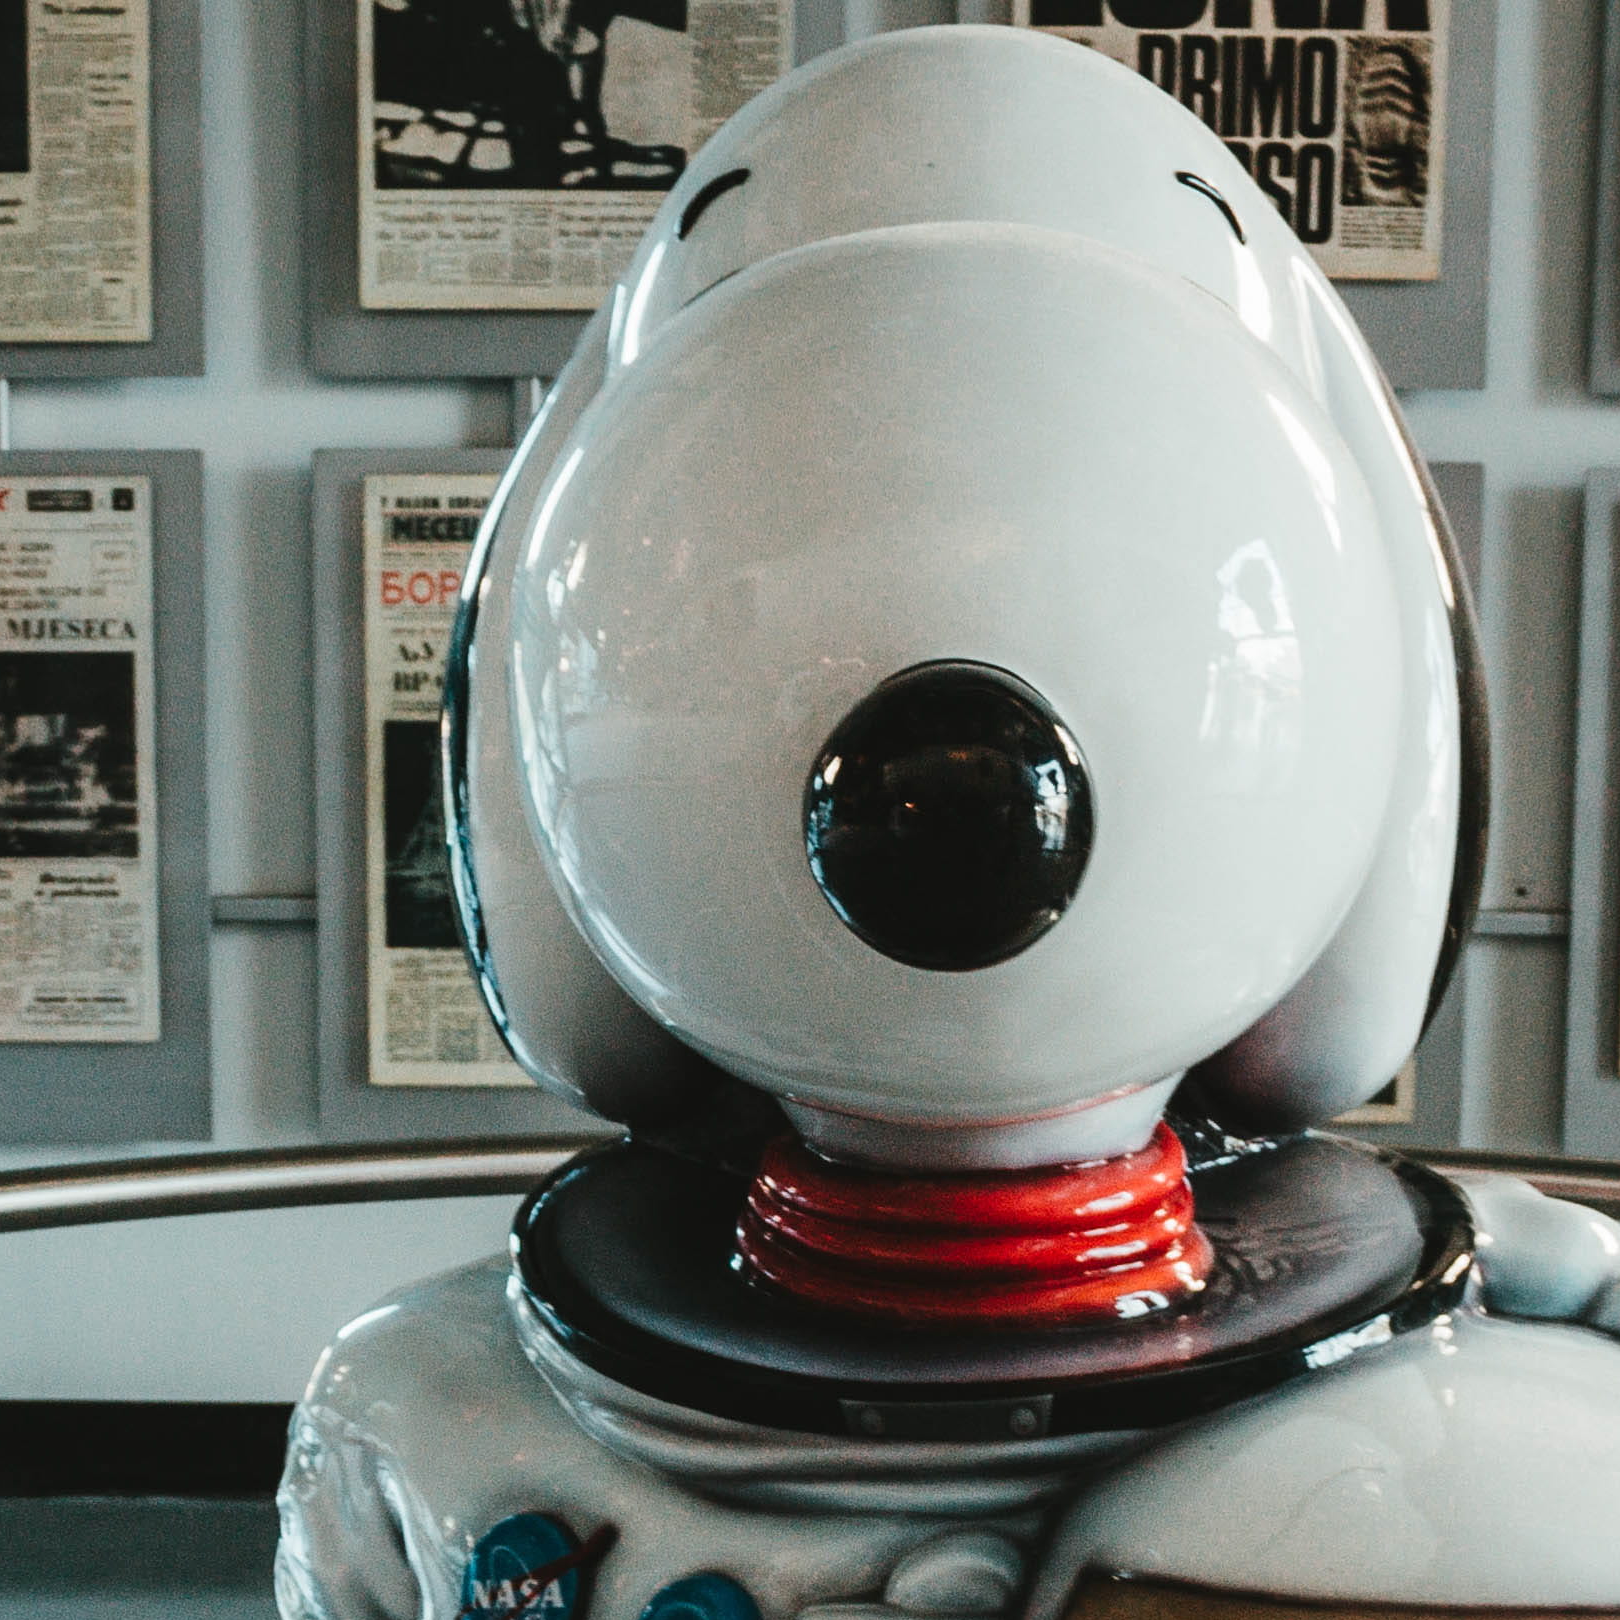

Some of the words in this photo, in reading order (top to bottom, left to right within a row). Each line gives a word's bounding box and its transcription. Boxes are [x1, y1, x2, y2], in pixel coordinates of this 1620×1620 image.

[380, 570, 461, 605] БОР
[7, 618, 137, 641] MJESECA
[472, 1578, 565, 1609] NASA
